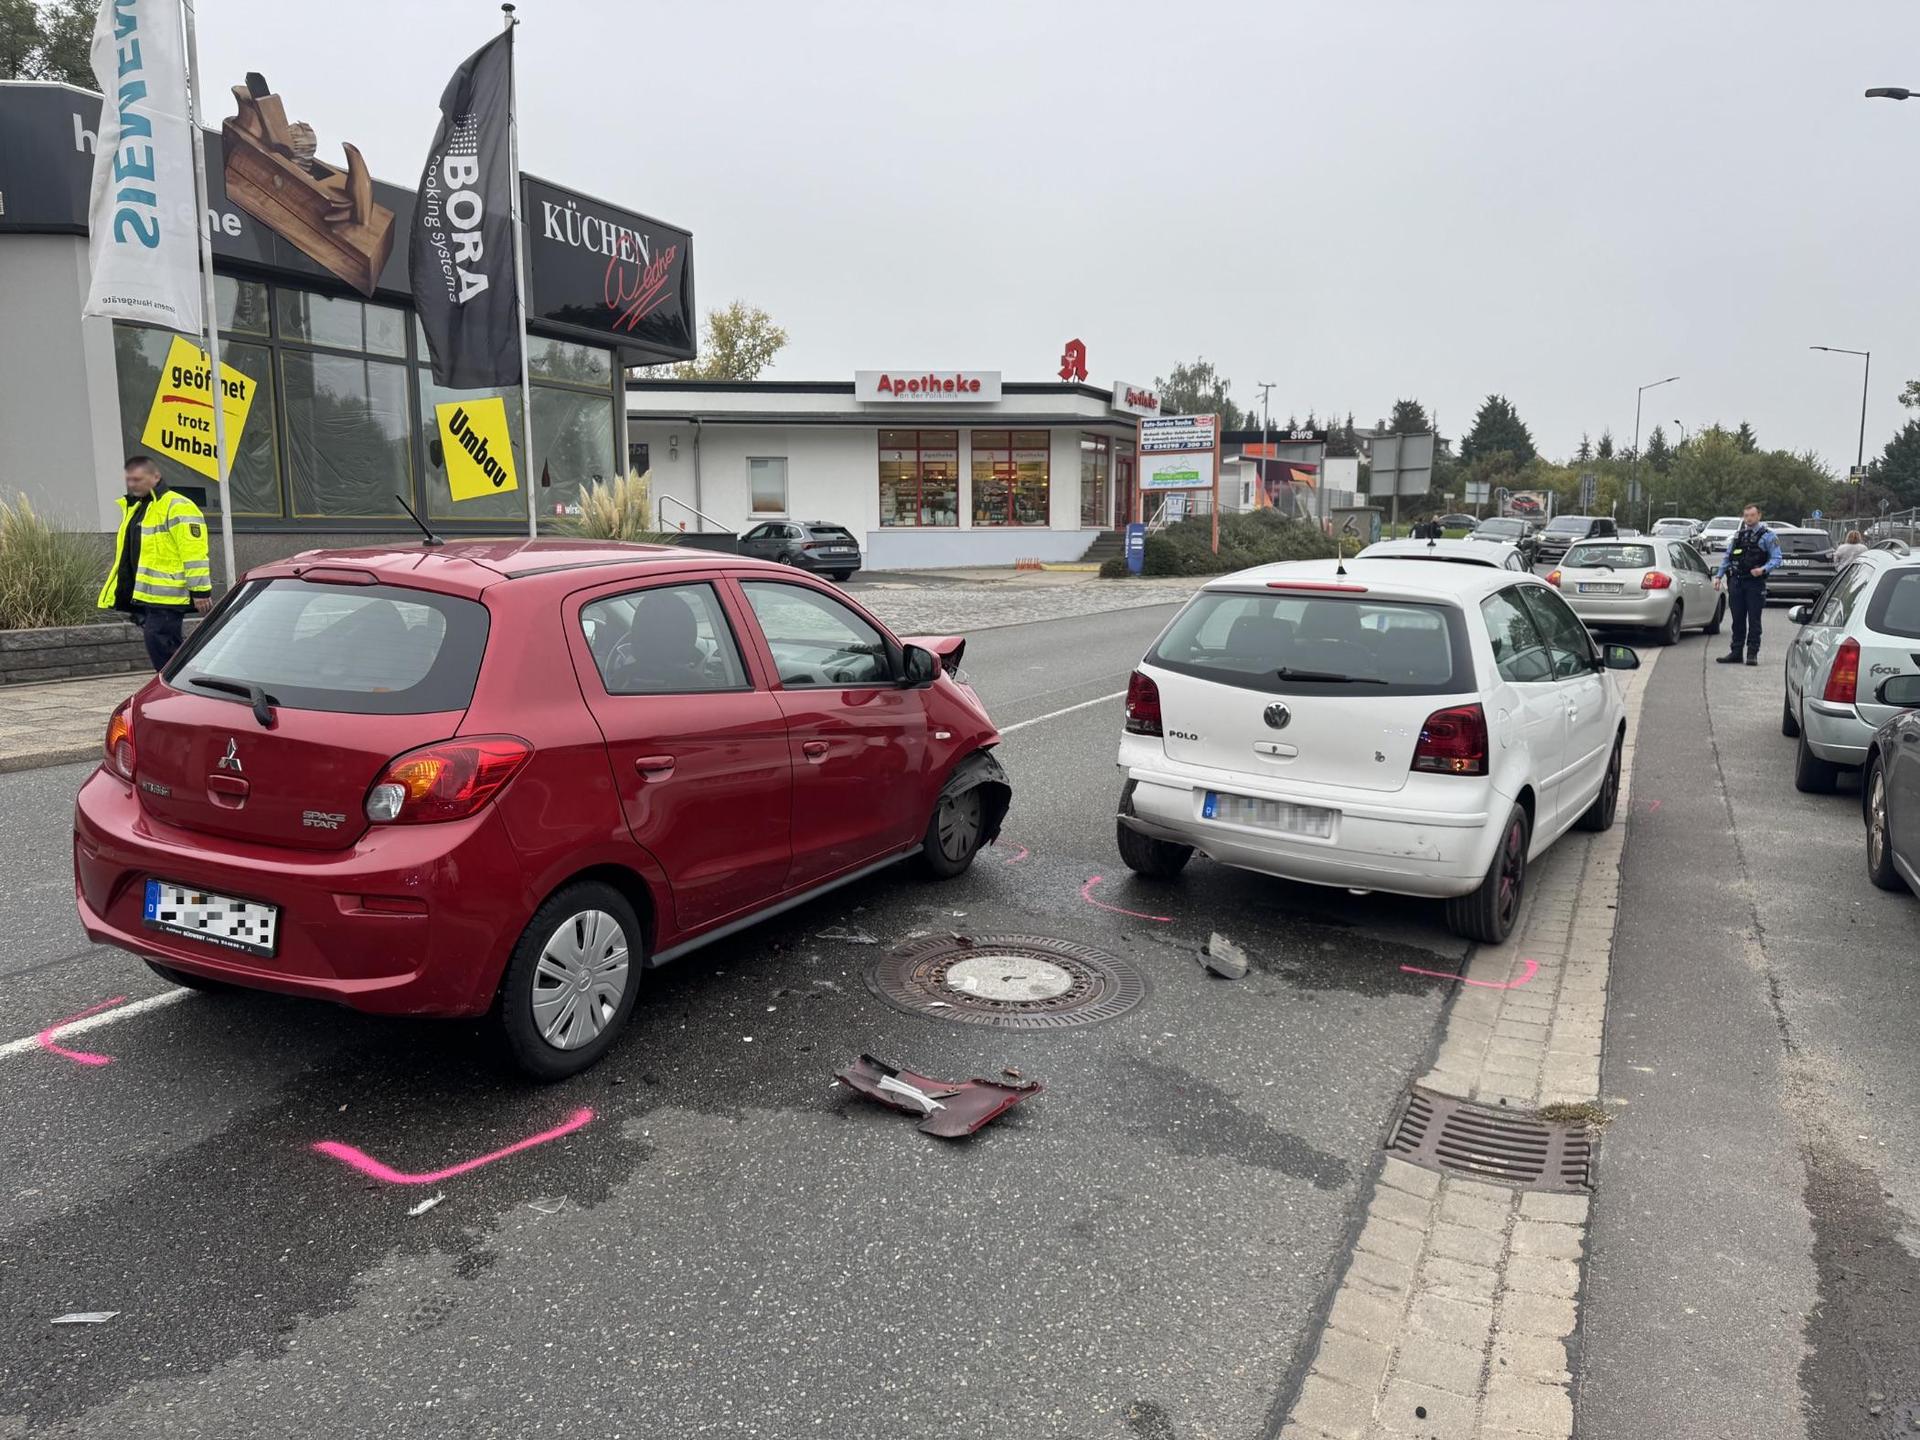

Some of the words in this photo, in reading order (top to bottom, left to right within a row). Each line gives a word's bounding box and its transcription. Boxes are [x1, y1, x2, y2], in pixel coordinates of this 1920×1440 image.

[443, 155, 489, 304] BORA
[541, 200, 650, 266] KÜCHEN
[430, 232, 457, 304] systems
[172, 366, 245, 401] geöfnet
[877, 374, 981, 397] Apotheke
[1125, 387, 1158, 410] Apotheke
[177, 412, 210, 432] trotz
[1290, 430, 1313, 440] SWS
[448, 406, 507, 488] Umbau
[1169, 730, 1198, 741] POLO
[303, 810, 346, 822] SPACE
[303, 819, 337, 830] STAR
